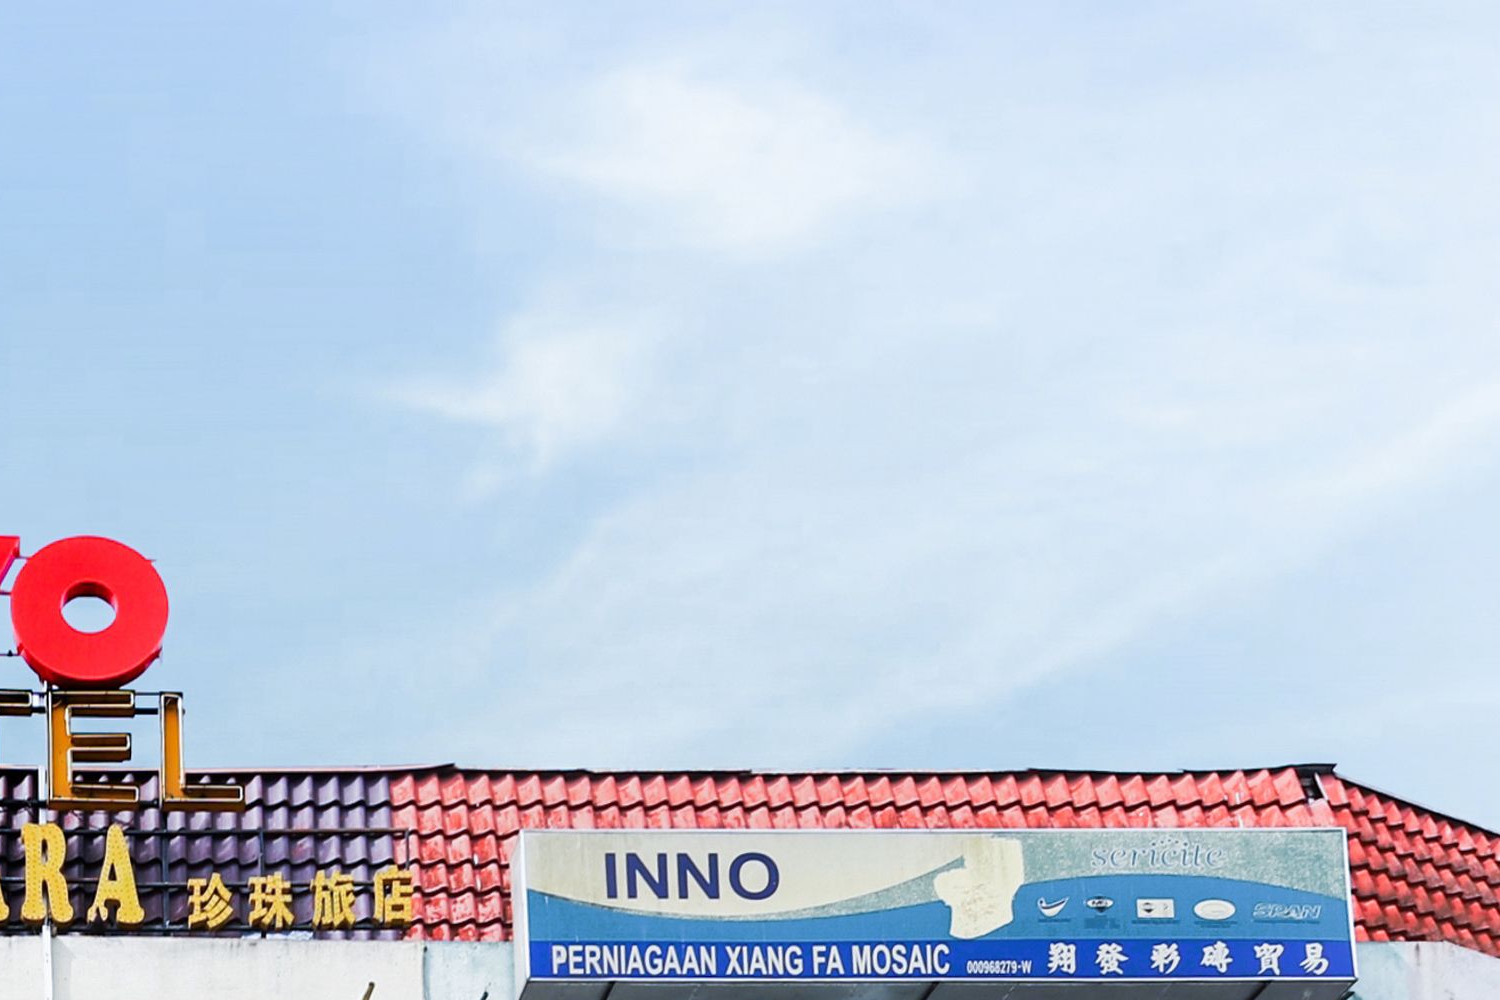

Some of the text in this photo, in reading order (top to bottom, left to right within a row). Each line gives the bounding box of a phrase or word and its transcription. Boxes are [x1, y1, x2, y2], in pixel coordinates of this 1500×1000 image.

[186, 866, 415, 931] 珍珠旅店
[603, 851, 780, 901] INNO
[551, 943, 1033, 976] PERNIAGAAN XIANG FA MOSAIC 000968279-W
